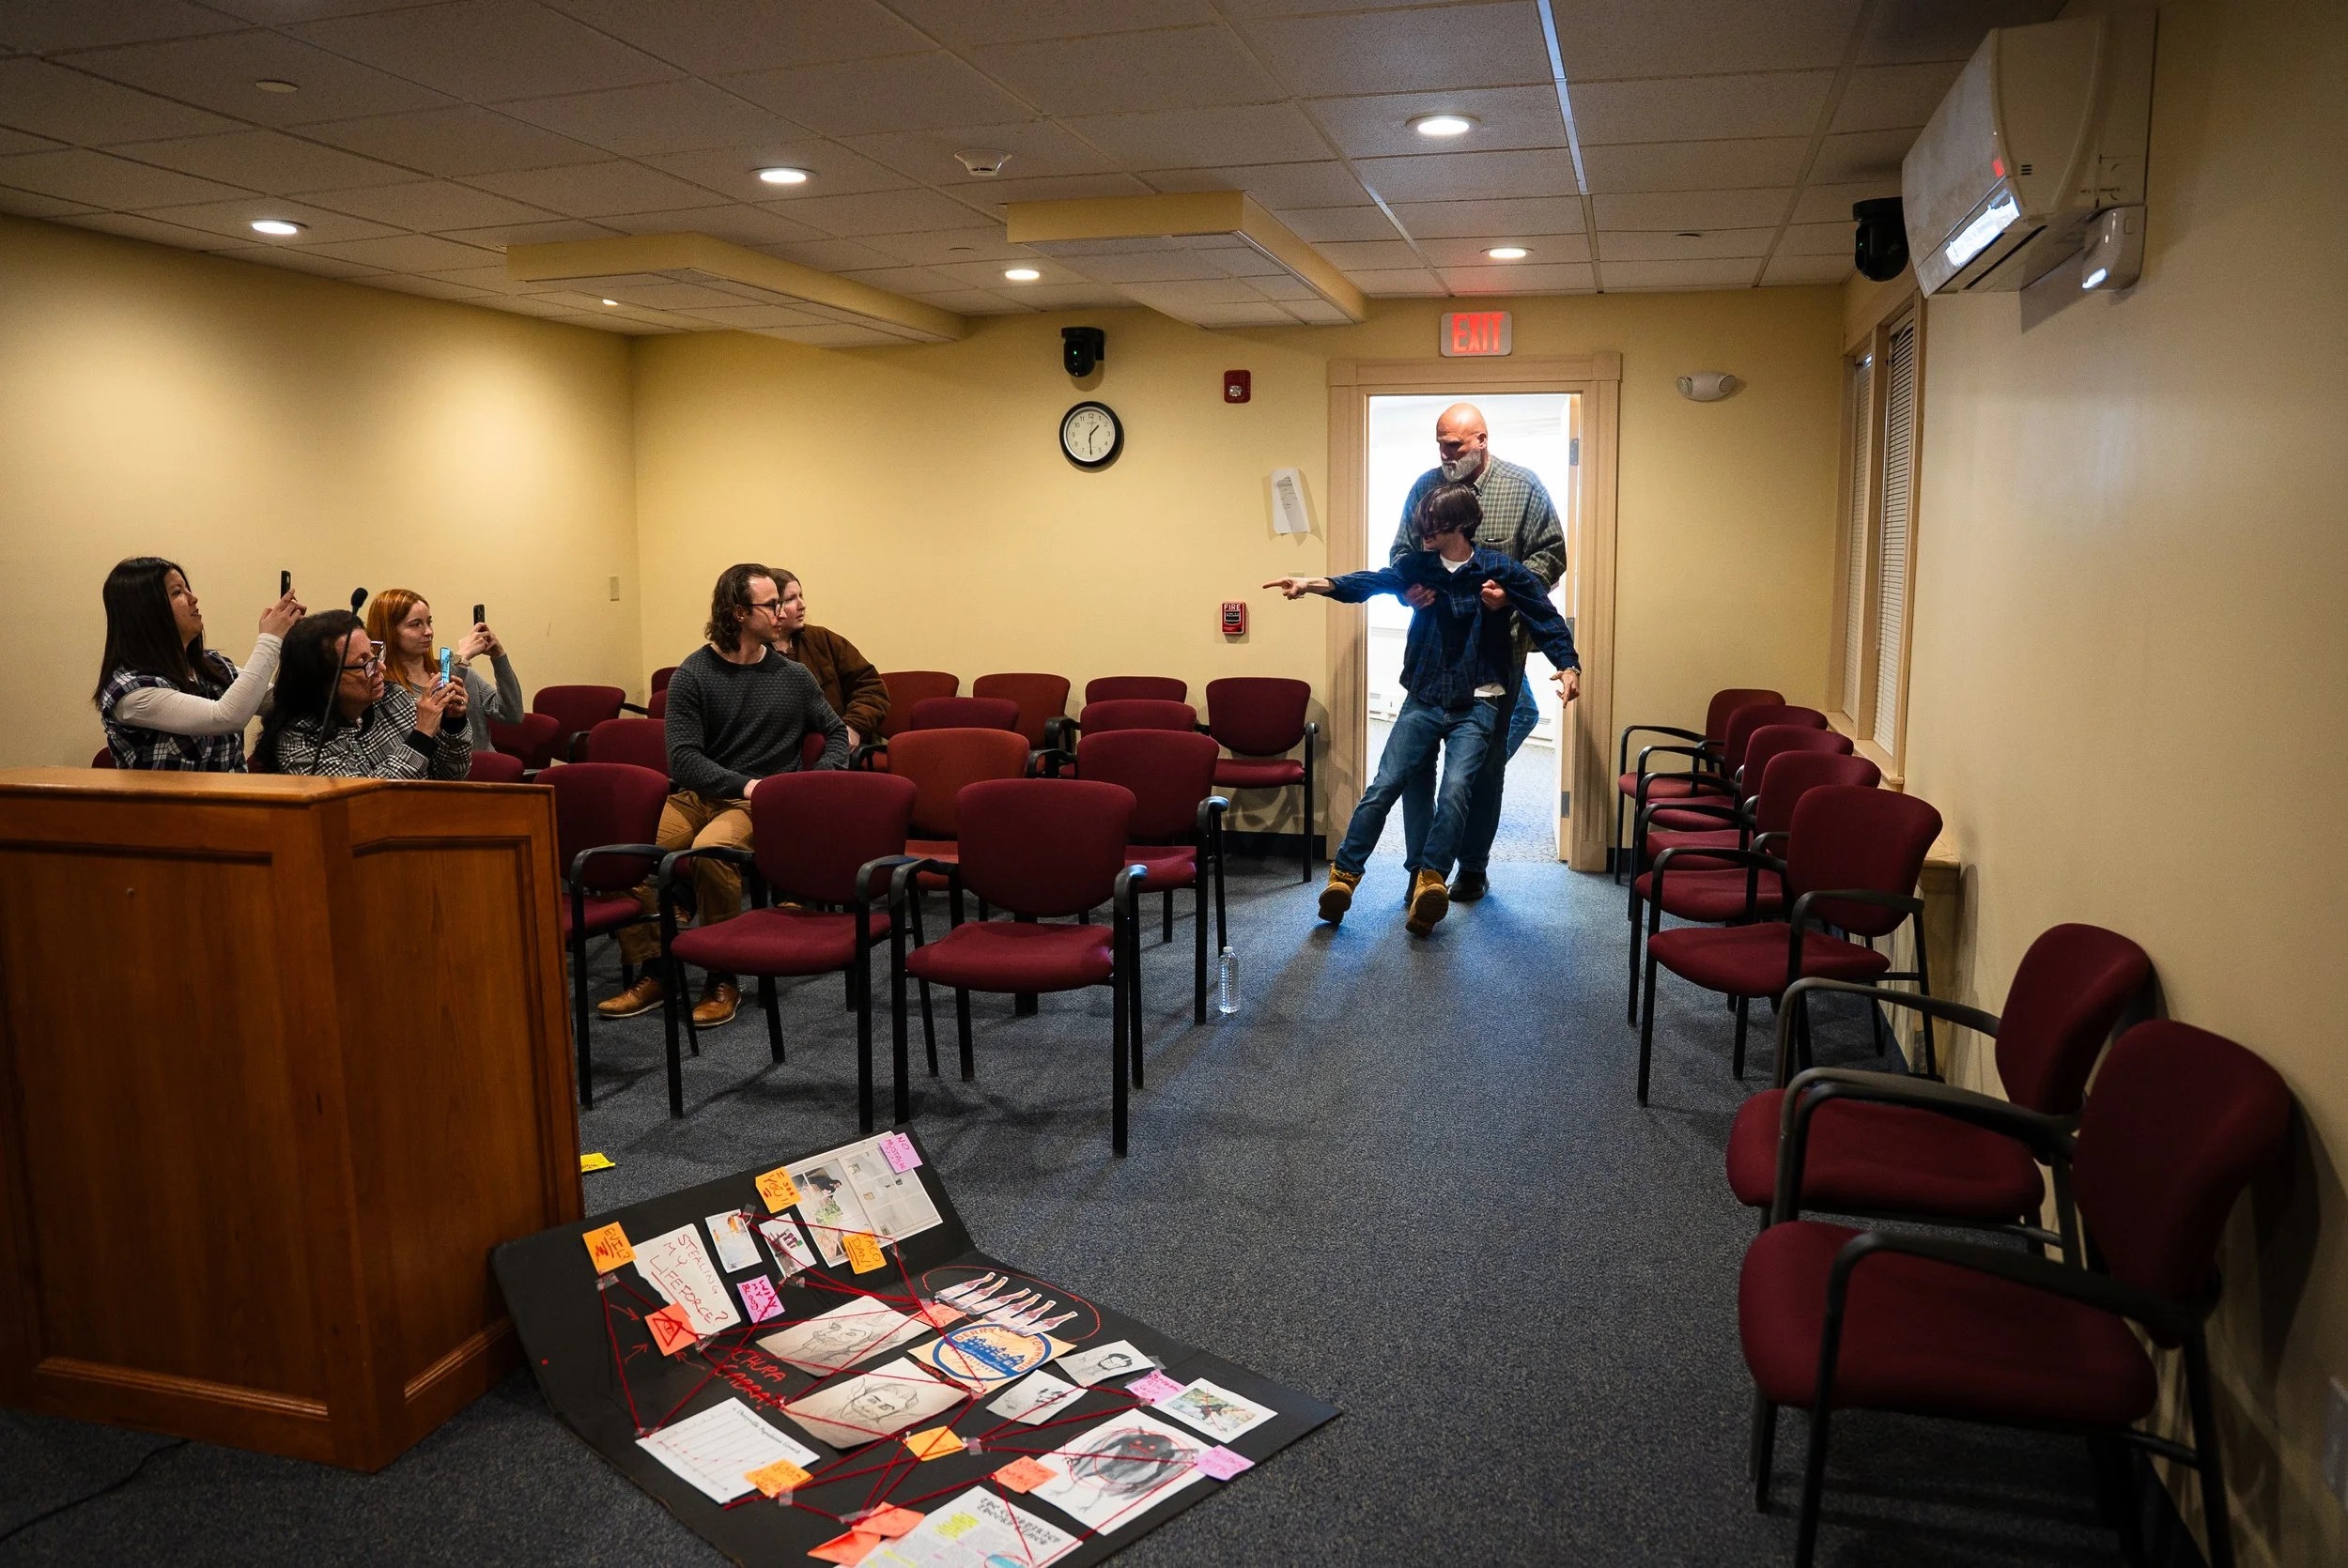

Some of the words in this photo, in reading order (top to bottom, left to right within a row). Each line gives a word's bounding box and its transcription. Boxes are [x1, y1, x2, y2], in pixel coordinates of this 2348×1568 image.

[1452, 312, 1503, 353] EXIT
[896, 1135, 910, 1151] NO
[663, 1239, 689, 1268] MY
[676, 1233, 719, 1296] STEALING
[863, 1234, 882, 1263] TACO
[751, 1283, 764, 1298] MY
[732, 1348, 787, 1383] CHUPA
[1017, 1336, 1044, 1372] TOWNSHIP
